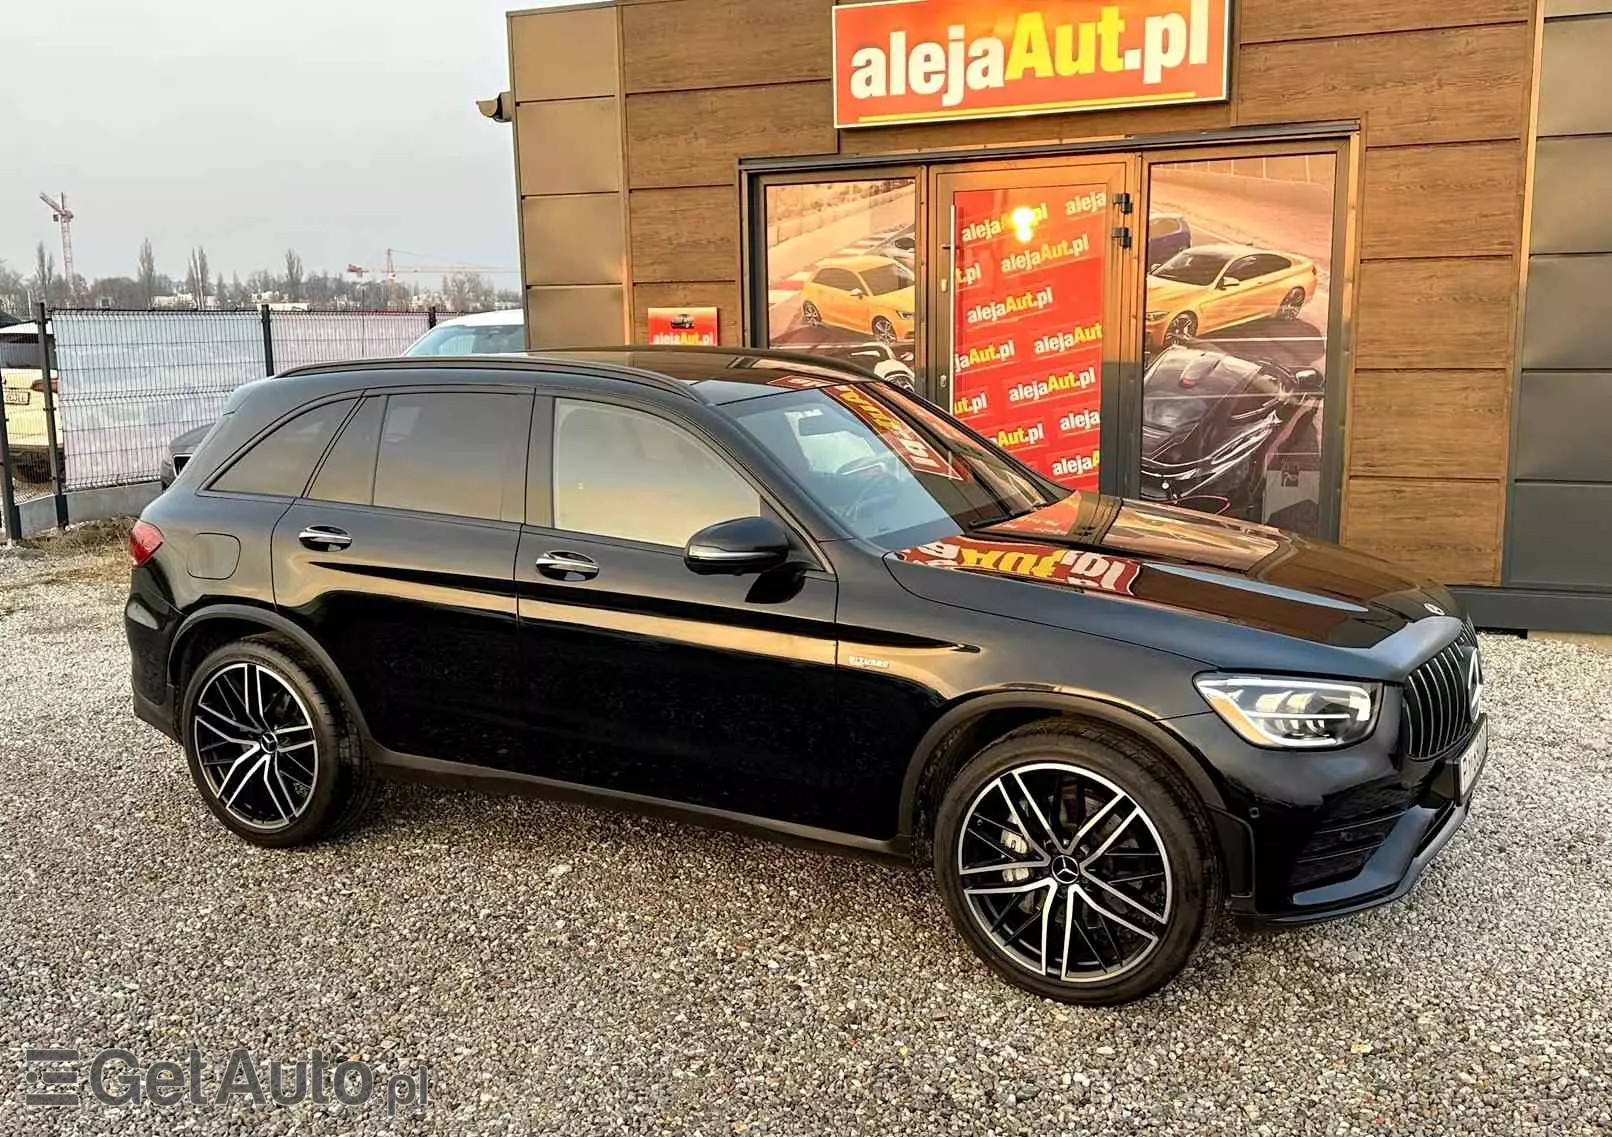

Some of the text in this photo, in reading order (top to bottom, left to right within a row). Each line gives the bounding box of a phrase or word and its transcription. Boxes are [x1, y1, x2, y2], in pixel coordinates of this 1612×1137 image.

[850, 0, 1208, 107] alejaAut.pl
[1065, 191, 1106, 216] aleja
[1001, 233, 1089, 273] alejaAut.pl
[967, 286, 1054, 324] alejaAut.pl
[1034, 322, 1103, 354] alejaAut
[1008, 367, 1096, 402] alejaAut.pl
[1059, 409, 1101, 431] aleja
